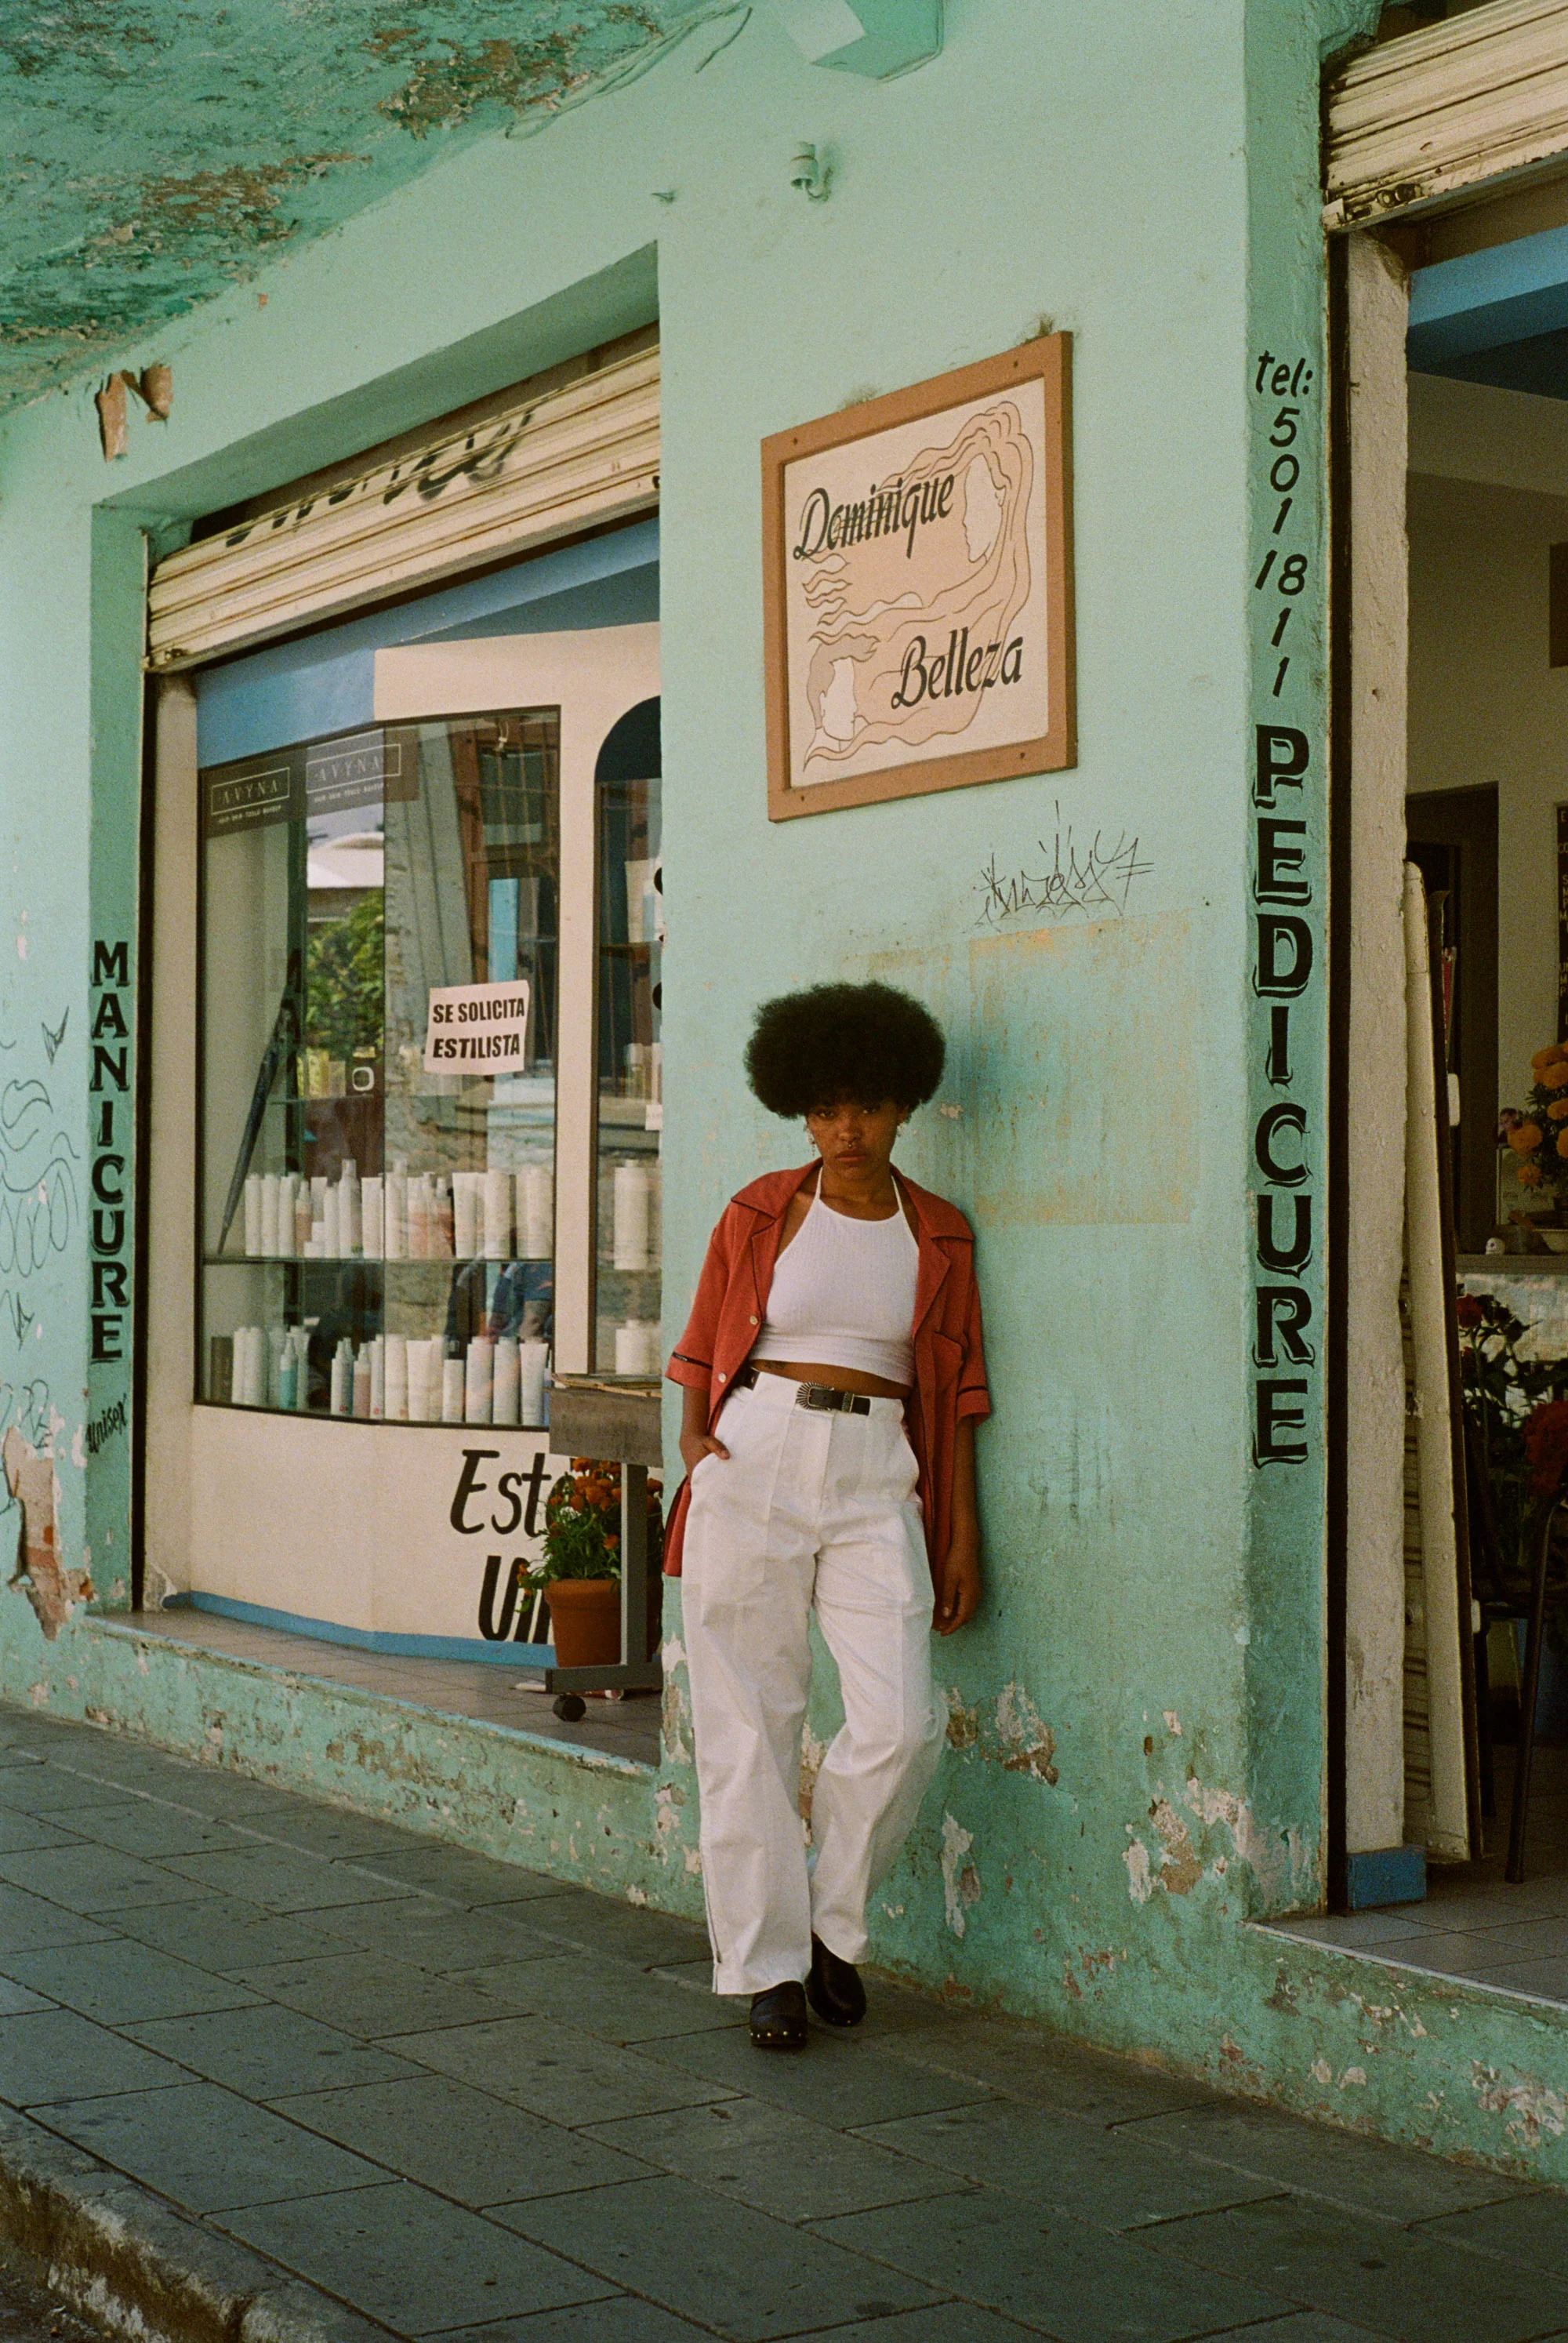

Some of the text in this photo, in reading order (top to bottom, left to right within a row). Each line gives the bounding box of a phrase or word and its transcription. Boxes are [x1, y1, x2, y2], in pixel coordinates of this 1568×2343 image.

[1255, 351, 1312, 398] tel:
[793, 474, 955, 560] Dominique
[891, 627, 1023, 710] Belleza
[433, 997, 524, 1023] SE SOLICITA
[433, 1033, 520, 1059] ESTILISTA
[1252, 724, 1316, 1470] PEDICURE
[89, 940, 131, 1364] MANICURE
